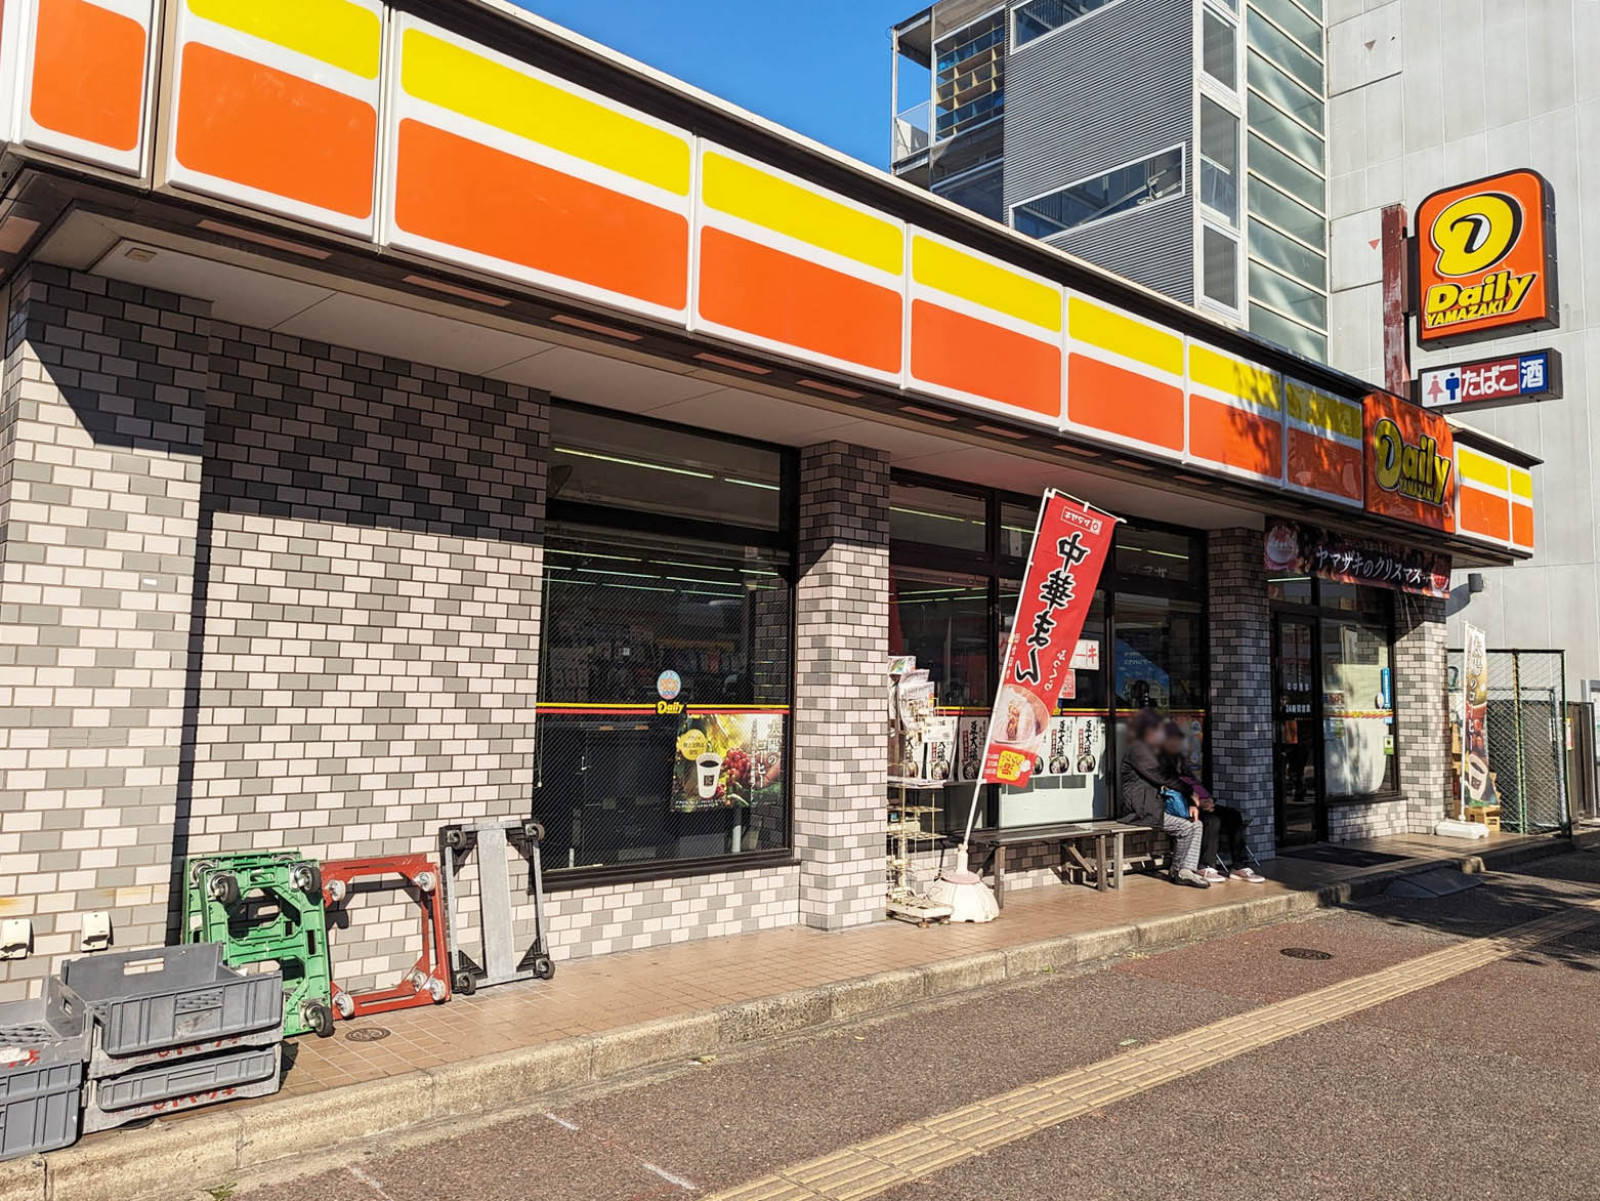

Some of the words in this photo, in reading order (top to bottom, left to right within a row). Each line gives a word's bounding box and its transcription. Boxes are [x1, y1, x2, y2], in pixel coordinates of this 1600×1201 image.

[1427, 271, 1537, 313] Daily
[1427, 302, 1503, 327] YAMAZAKI
[1462, 364, 1518, 397] たばこ
[1521, 358, 1545, 388] 酒
[1375, 419, 1451, 504] Daily
[657, 701, 684, 714] Daily
